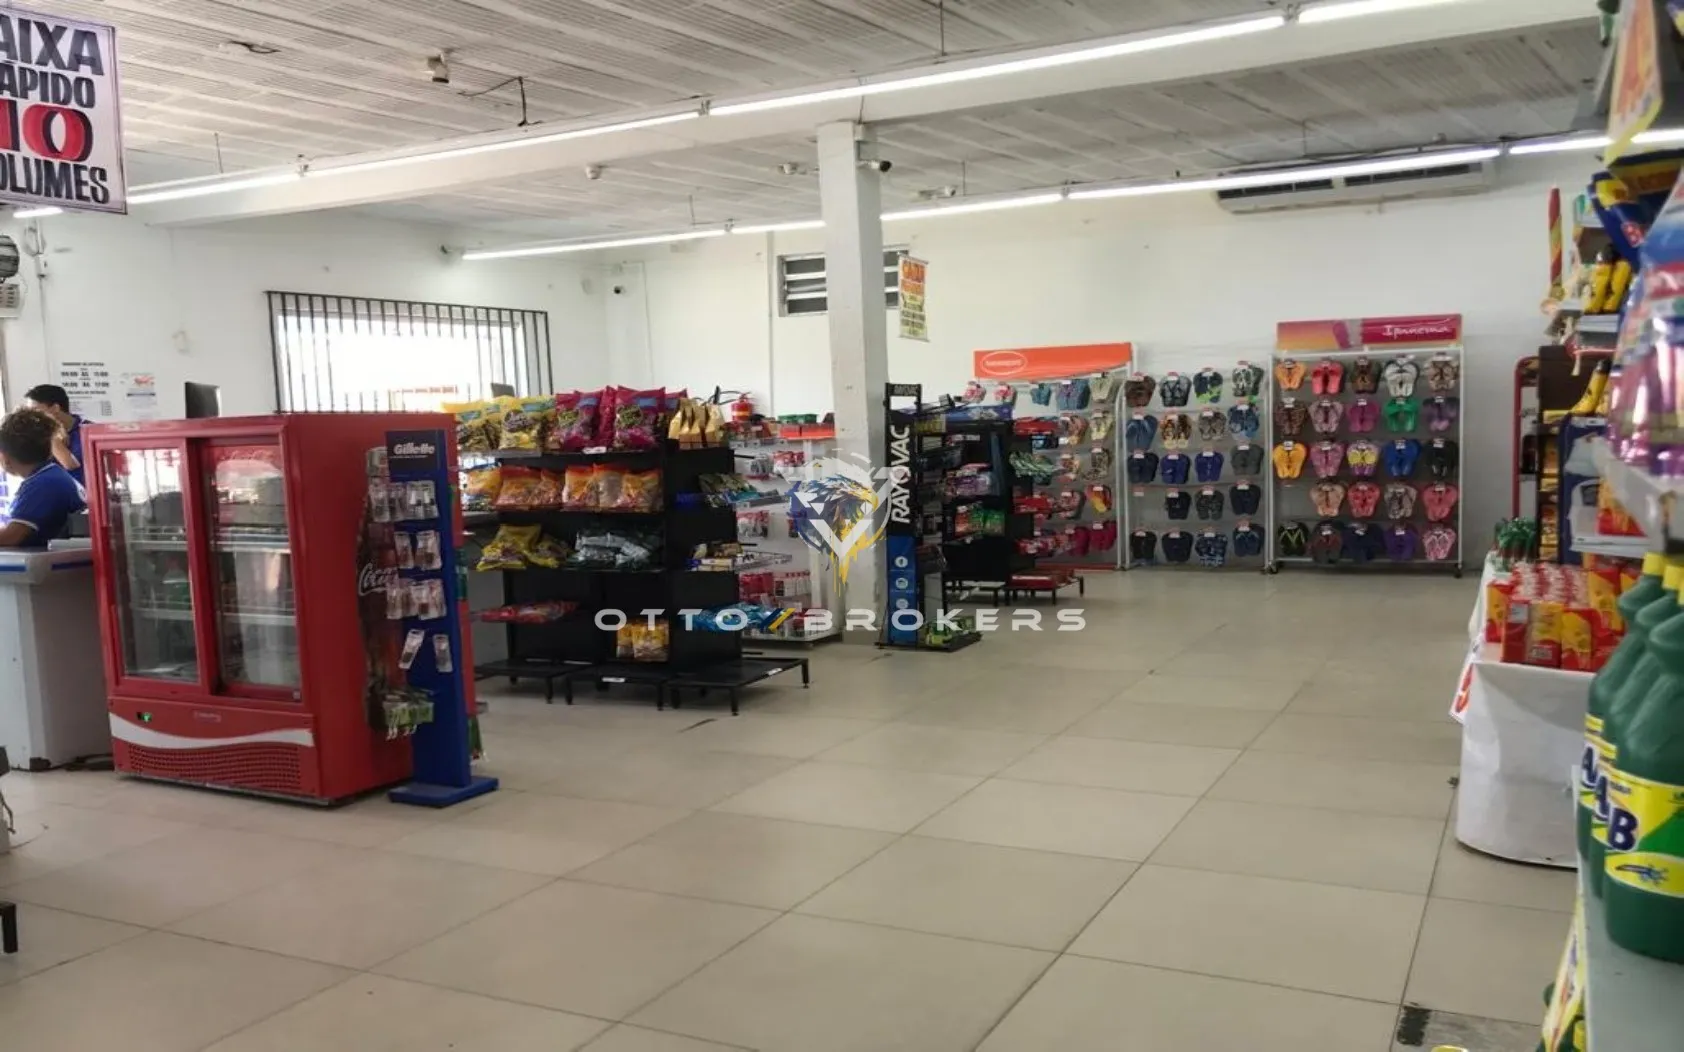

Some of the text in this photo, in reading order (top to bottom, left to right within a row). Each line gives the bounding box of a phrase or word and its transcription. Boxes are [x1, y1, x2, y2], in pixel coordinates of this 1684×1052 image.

[1382, 324, 1450, 340] Ipanema
[393, 442, 436, 455] Gillette
[890, 425, 911, 523] RAYOVAC
